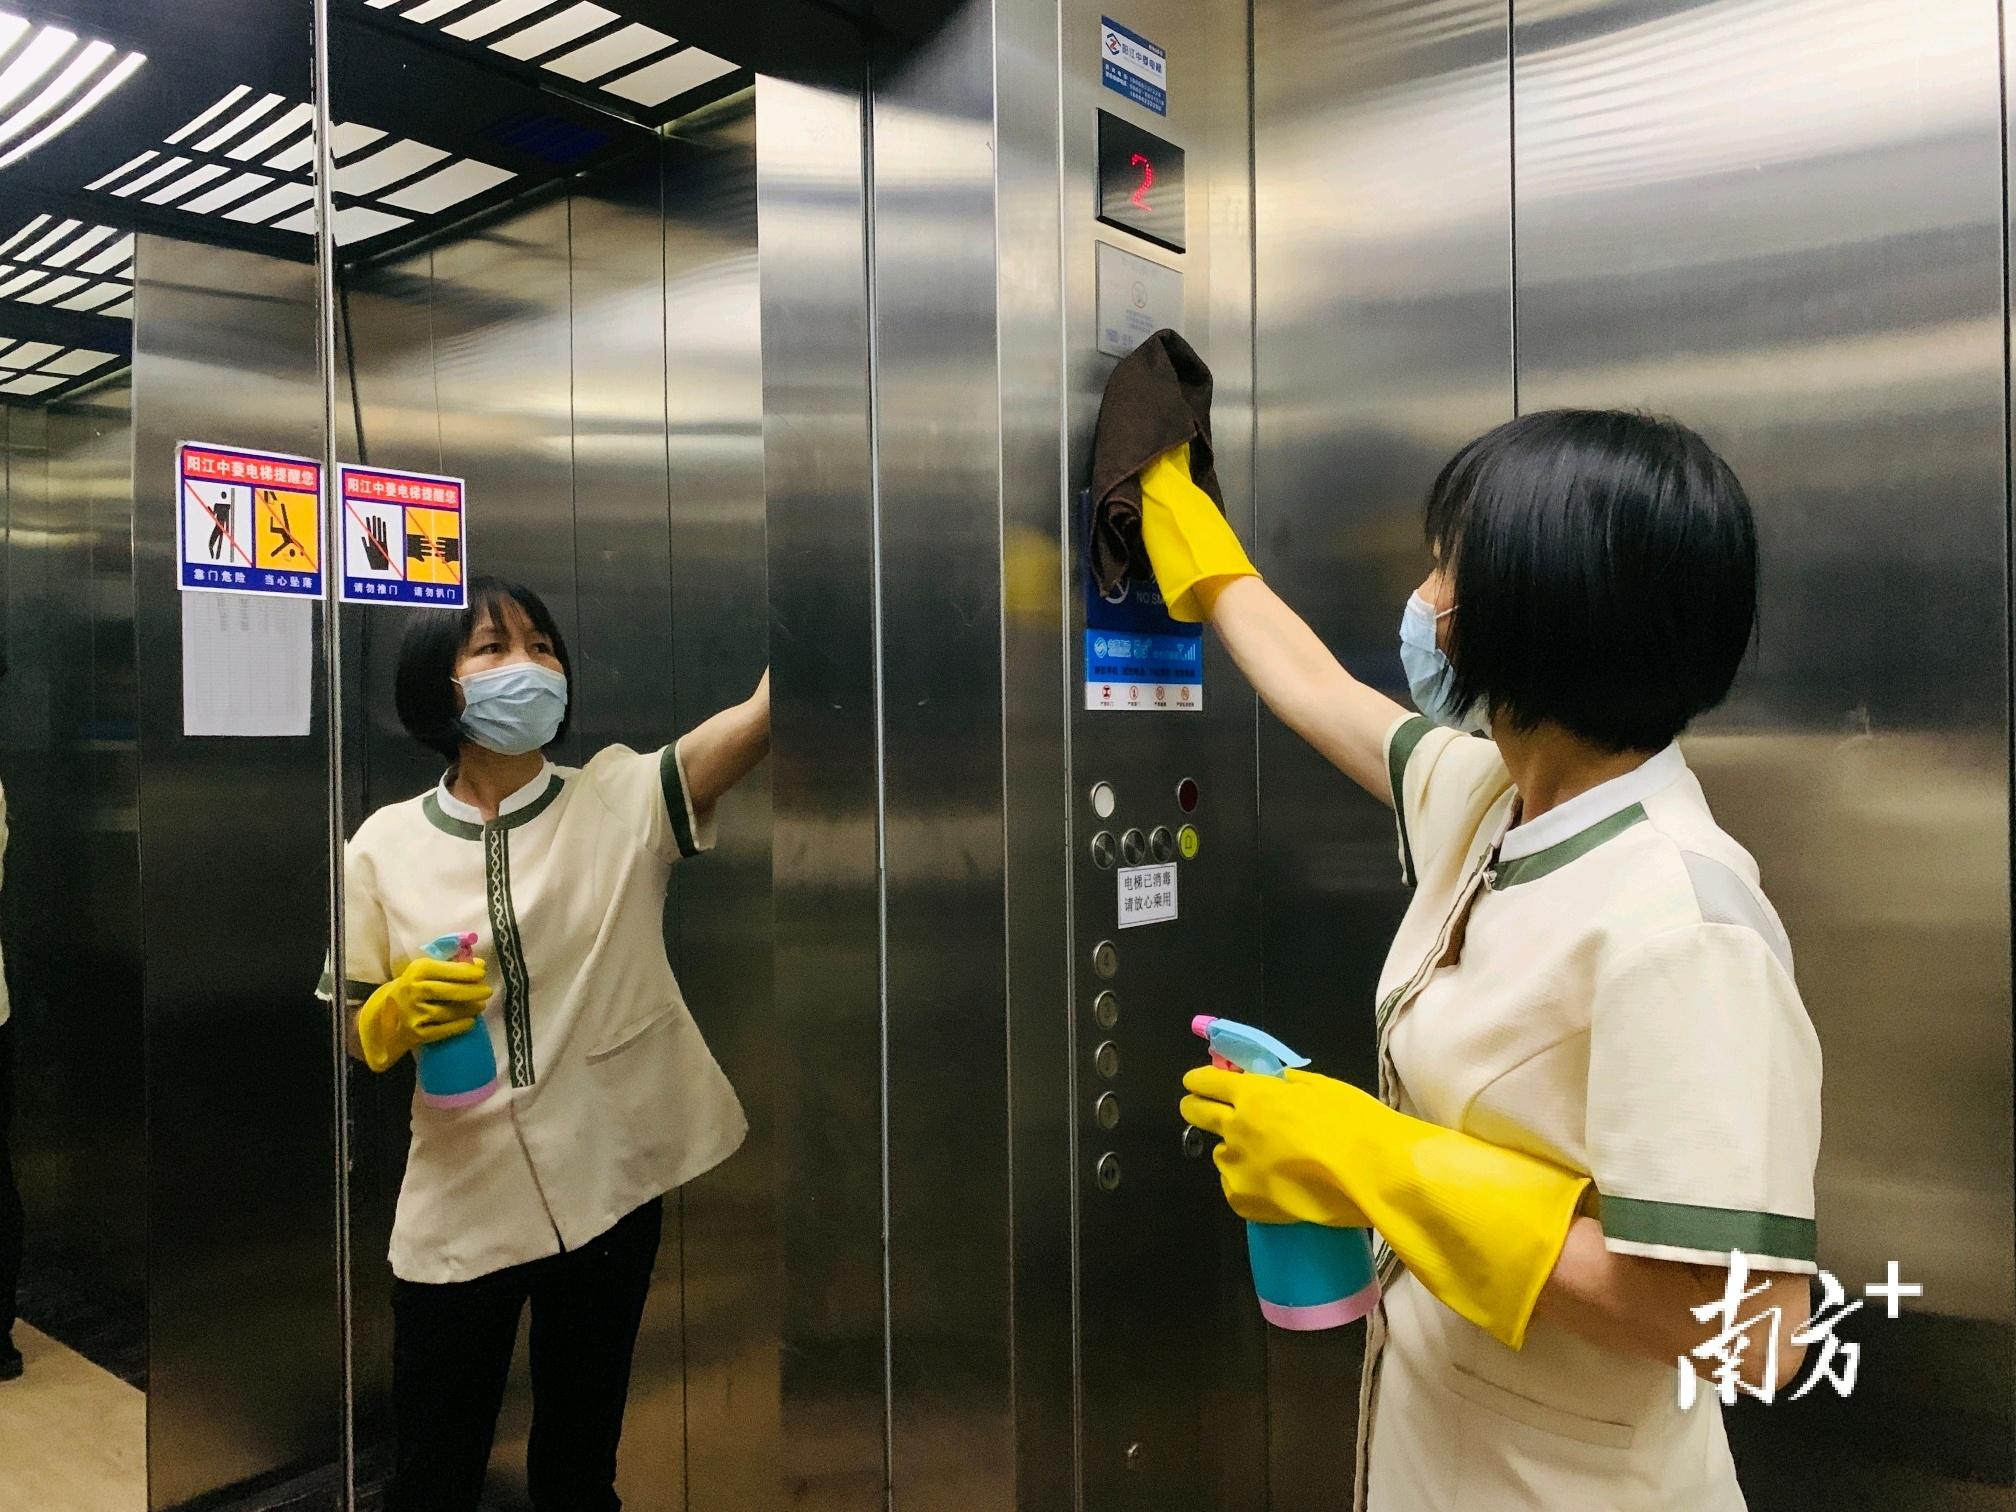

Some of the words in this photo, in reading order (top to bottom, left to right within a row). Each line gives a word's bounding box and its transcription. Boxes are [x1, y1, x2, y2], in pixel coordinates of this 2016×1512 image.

[1131, 153, 1154, 212] 2
[187, 455, 315, 486] 阳江中菱电梯提醒您
[347, 477, 458, 504] 阳江中菱电梯提醒您
[193, 569, 247, 584] 靠门危险
[264, 574, 313, 589] 当心坠落
[353, 582, 398, 596] 请勿推门
[413, 586, 456, 600] 请勿扒门
[1124, 871, 1171, 891] 电梯已消毒
[1124, 892, 1171, 912] 请放心乘用
